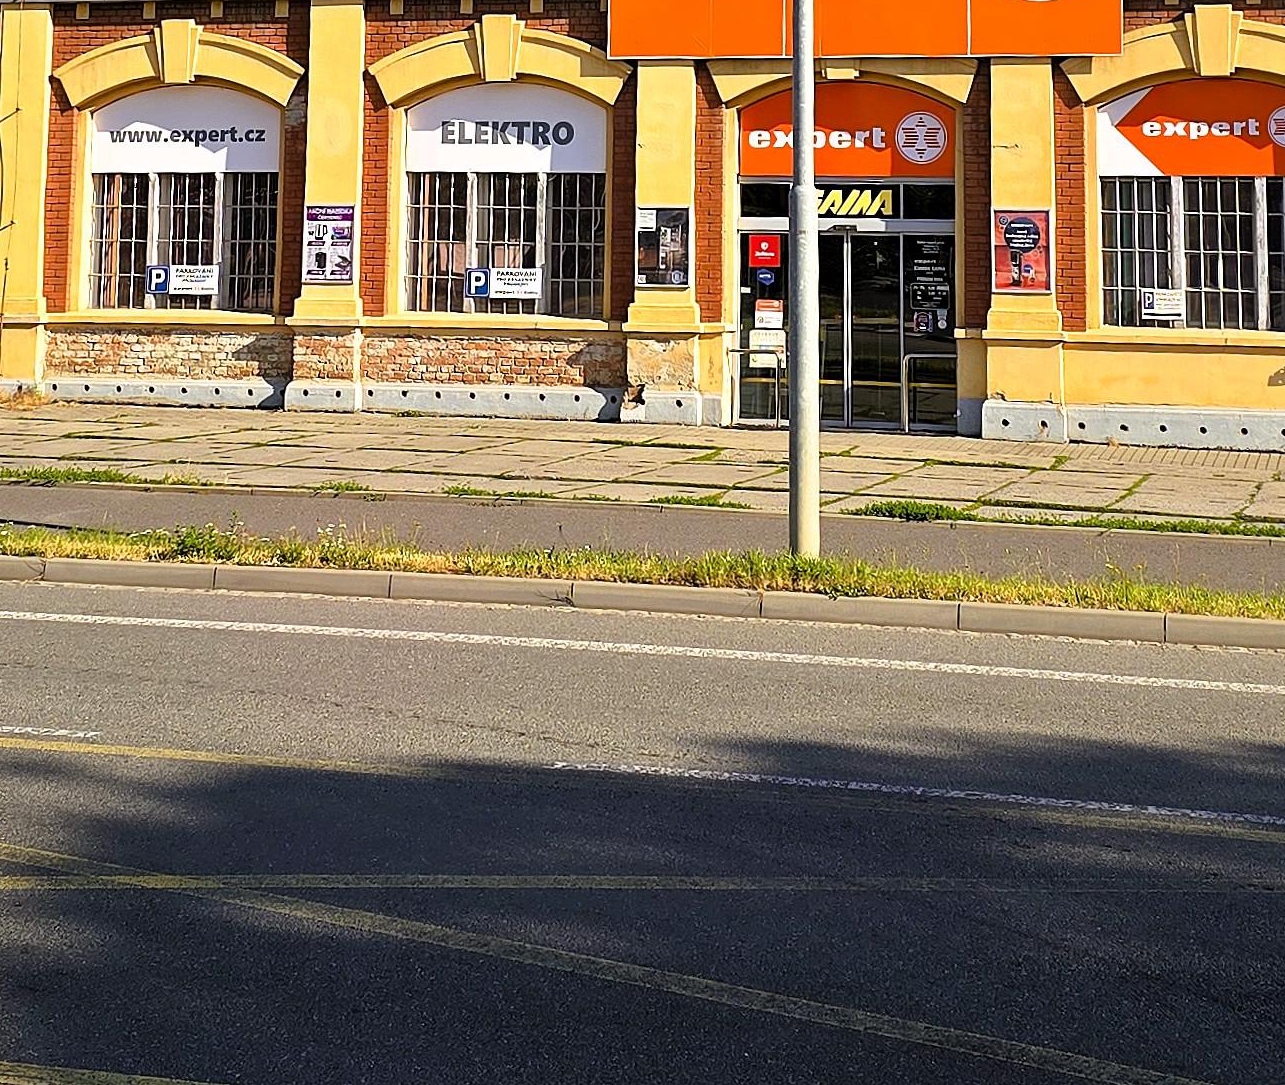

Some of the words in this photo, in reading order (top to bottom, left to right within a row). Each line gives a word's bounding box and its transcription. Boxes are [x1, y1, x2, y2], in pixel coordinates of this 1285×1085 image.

[109, 126, 266, 147] www.expert.cz
[441, 120, 575, 146] ELEKTRO
[1141, 118, 1260, 140] expert
[150, 268, 166, 291] P
[470, 271, 486, 295] P
[1144, 292, 1153, 308] P
